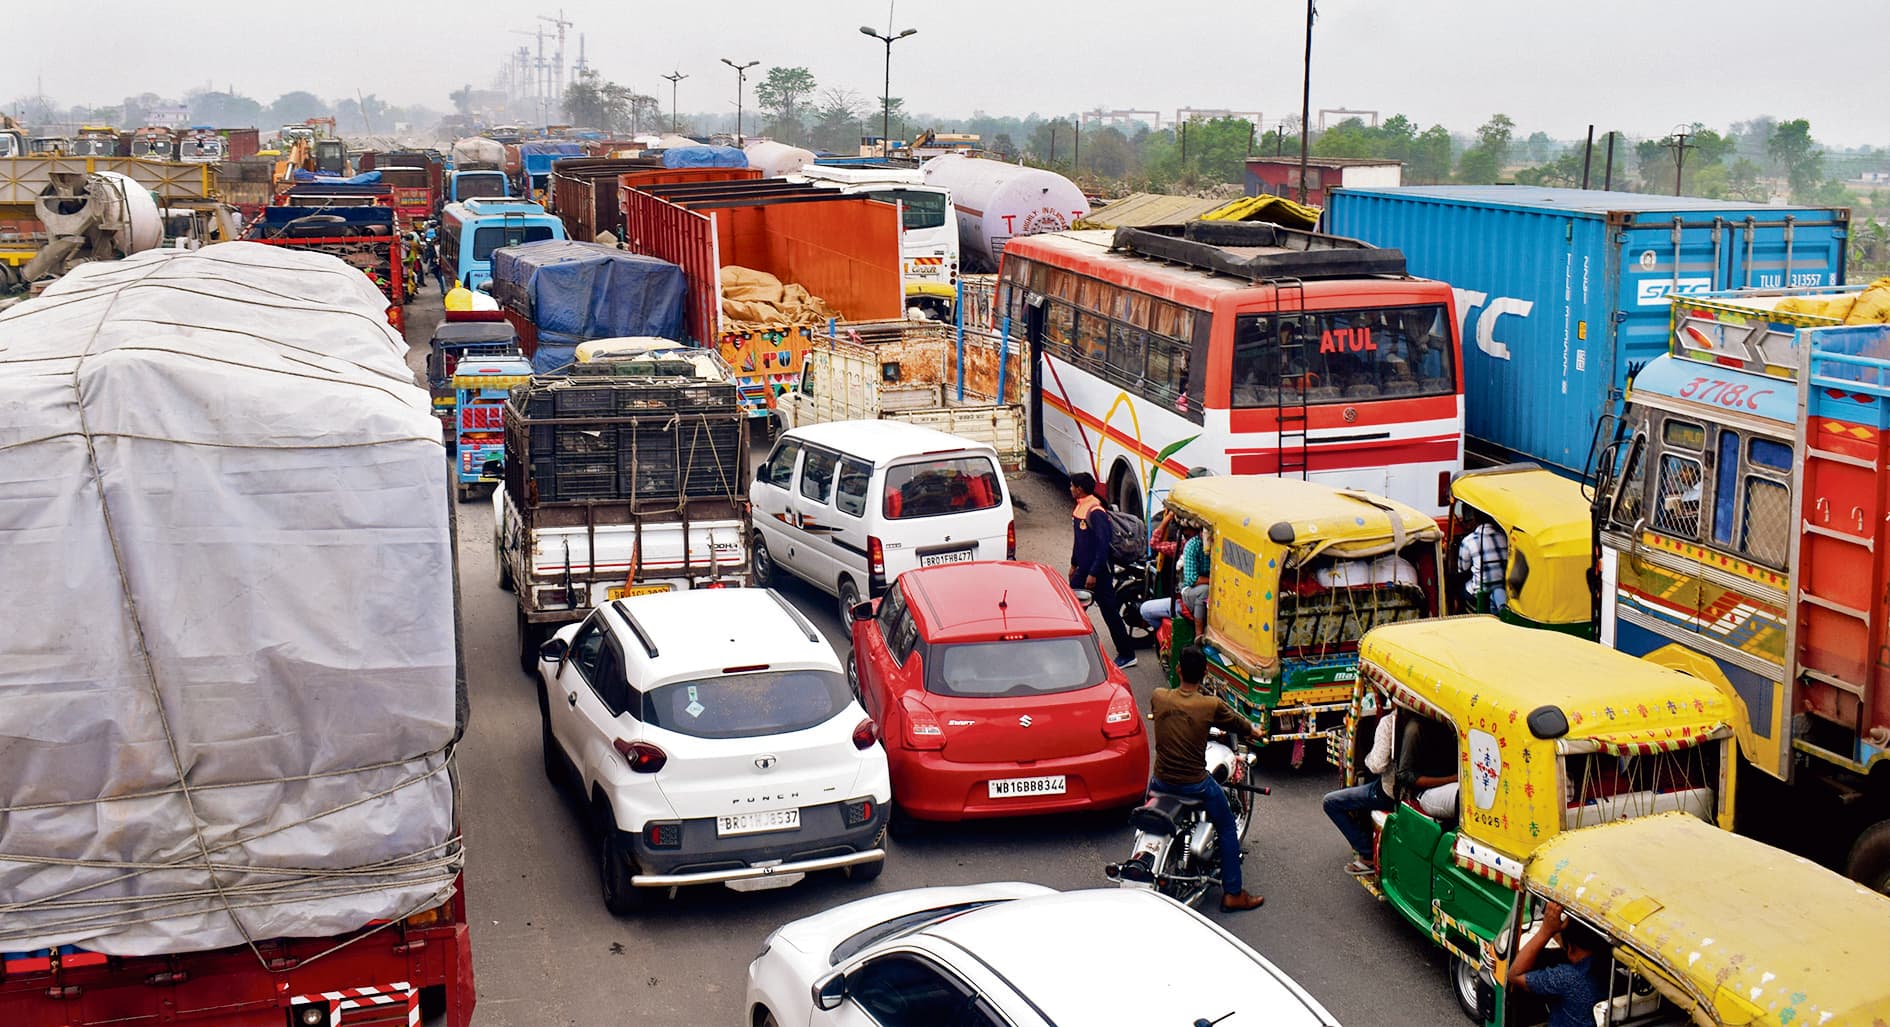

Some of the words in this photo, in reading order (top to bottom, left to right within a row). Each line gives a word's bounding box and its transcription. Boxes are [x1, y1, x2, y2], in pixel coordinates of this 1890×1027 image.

[1001, 215, 1016, 233] T
[1760, 274, 1781, 287] TLLU
[1791, 273, 1821, 287] 313557
[1829, 273, 1836, 286] 8
[1452, 288, 1534, 360] TC
[1320, 327, 1377, 353] ATUL
[1680, 377, 1774, 409] 3718.C
[1588, 723, 1707, 741] ELCOM
[996, 779, 1064, 794] WB16BB8344
[733, 792, 799, 804] PUNCH
[1474, 812, 1500, 828] 2025
